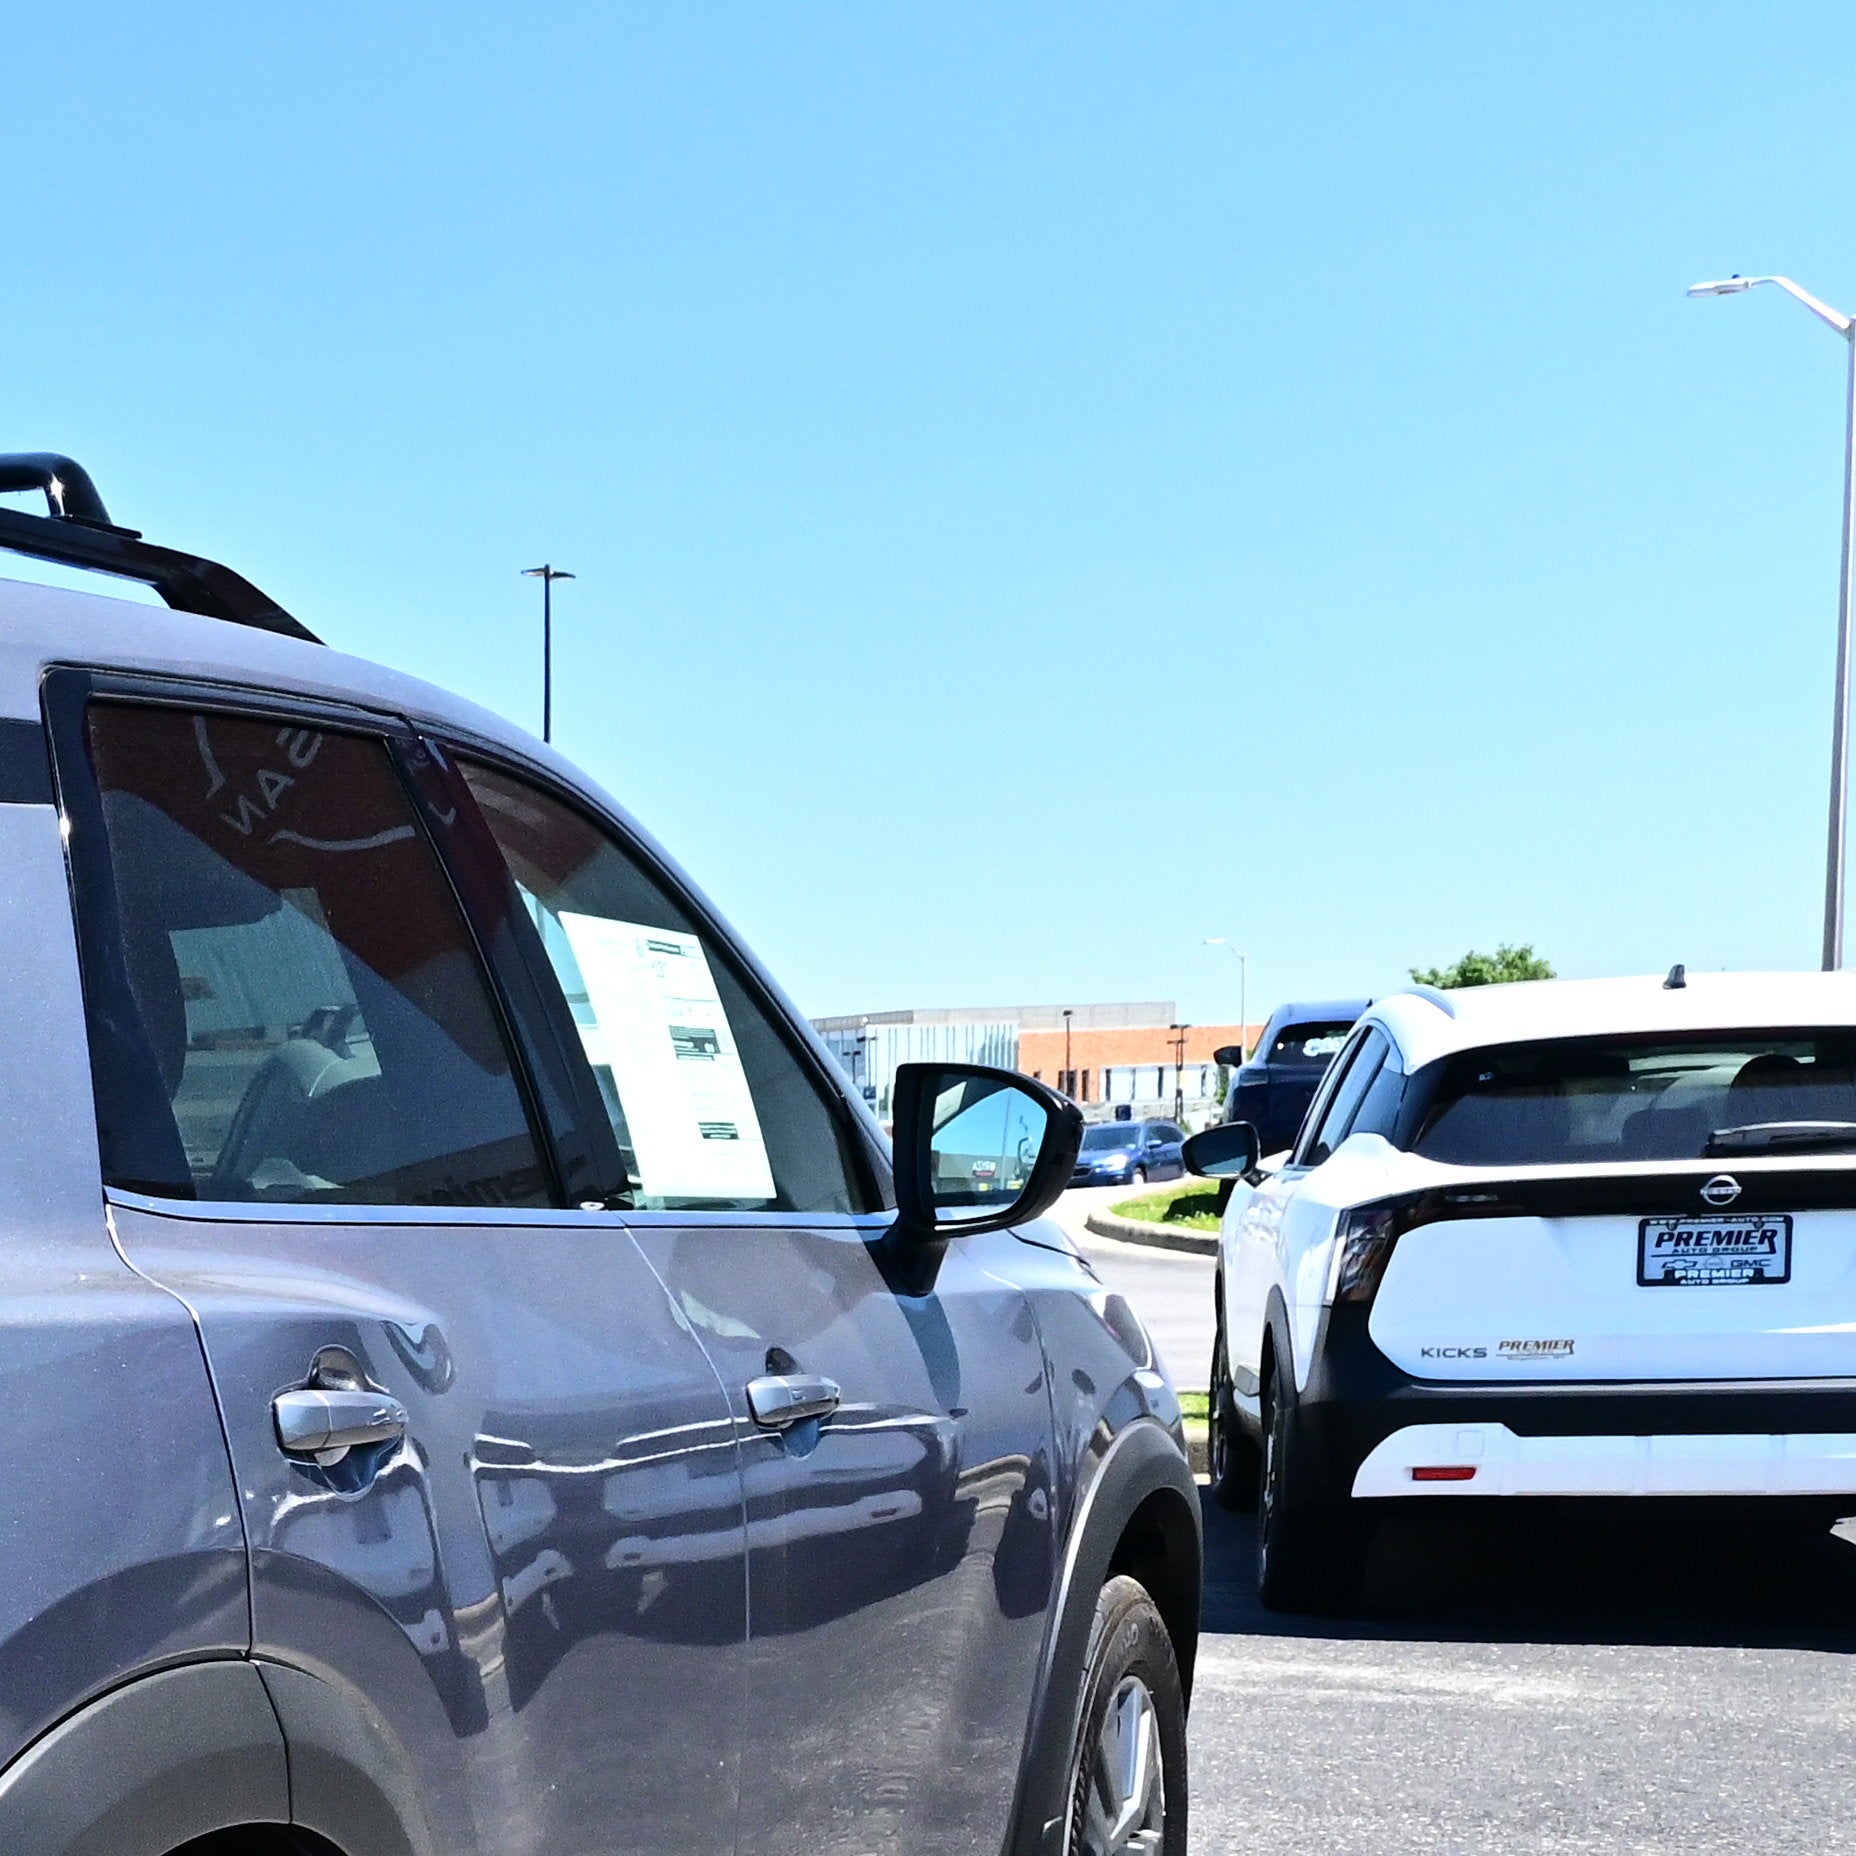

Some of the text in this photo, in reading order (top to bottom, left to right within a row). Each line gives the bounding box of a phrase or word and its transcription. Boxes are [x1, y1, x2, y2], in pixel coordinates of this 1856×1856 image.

[1654, 1229, 1778, 1254] PREMIER
[1730, 1259, 1771, 1267] GMC
[1674, 1268, 1755, 1279] PREMIER
[1421, 1347, 1488, 1359] KICKS
[1498, 1339, 1576, 1355] PREMIER
